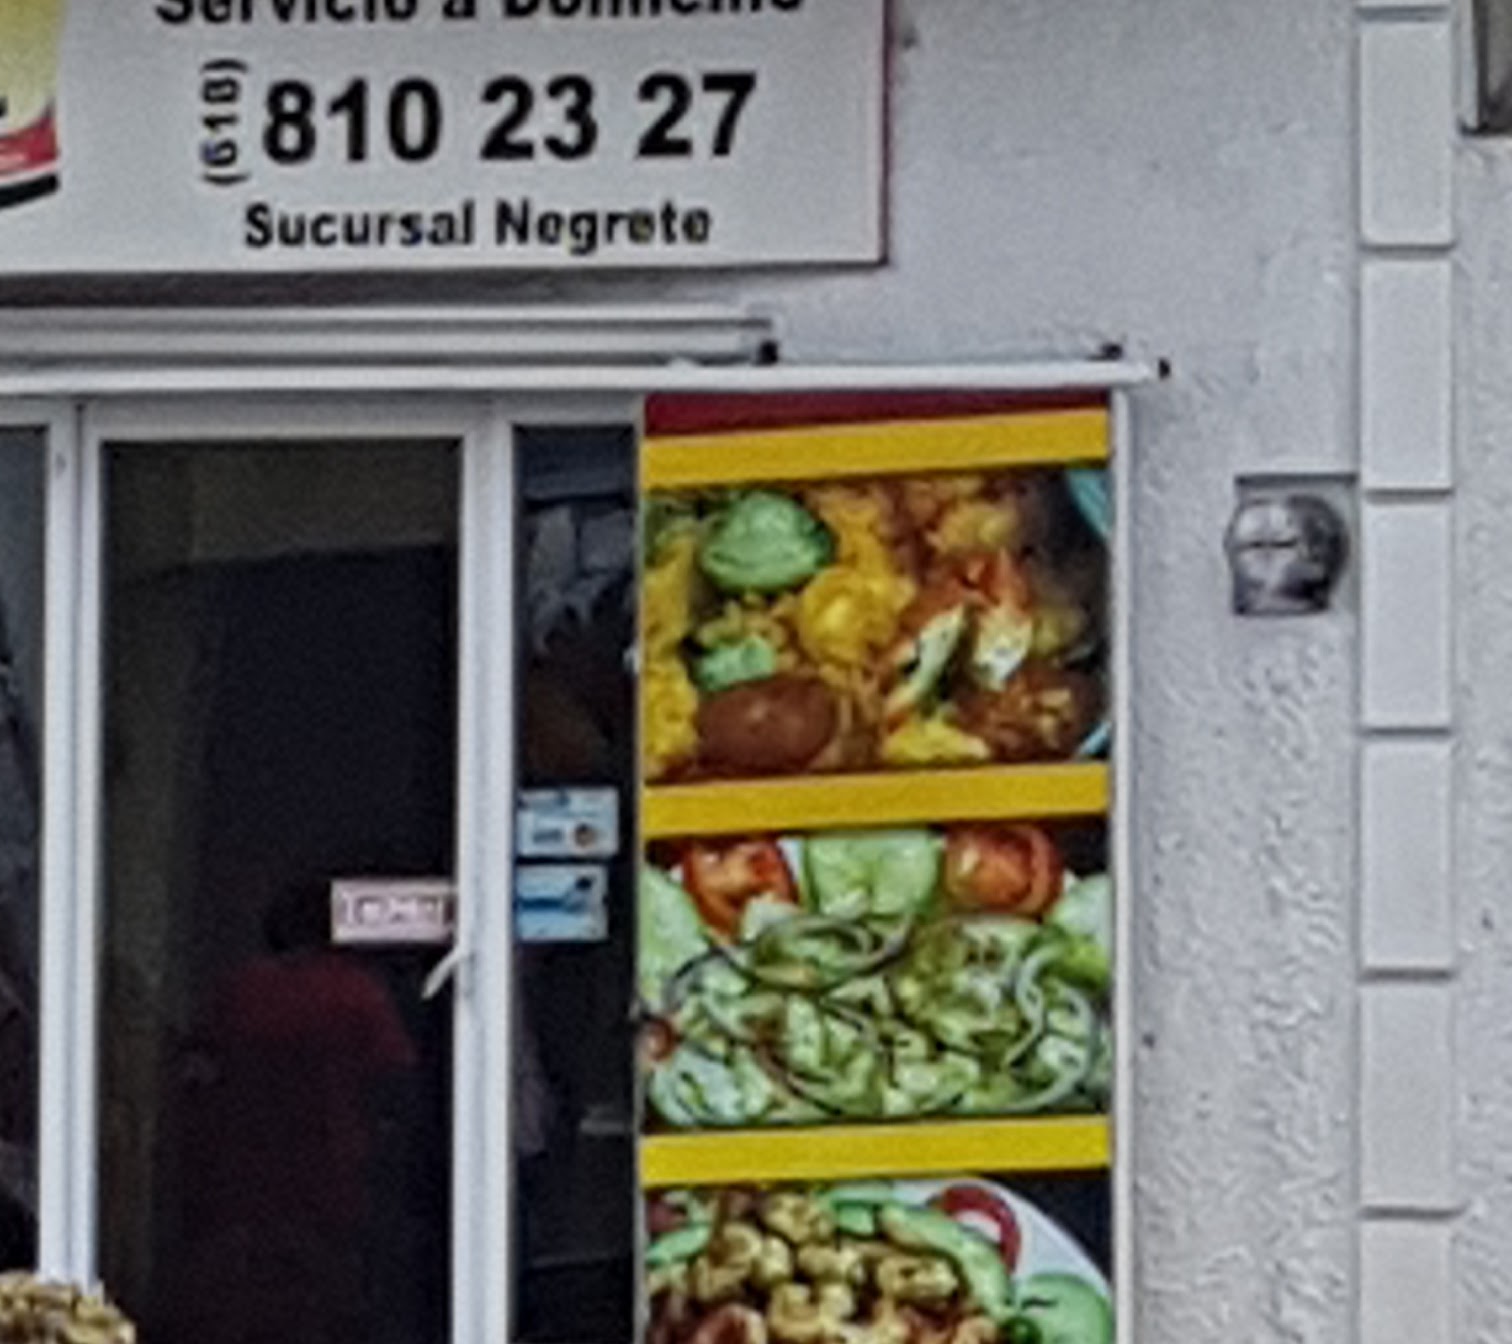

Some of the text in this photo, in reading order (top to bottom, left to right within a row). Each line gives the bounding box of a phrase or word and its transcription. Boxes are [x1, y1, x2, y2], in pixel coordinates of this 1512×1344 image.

[199, 57, 759, 187] (618) 810 23 27
[243, 197, 712, 256] Sucursal Negrete
